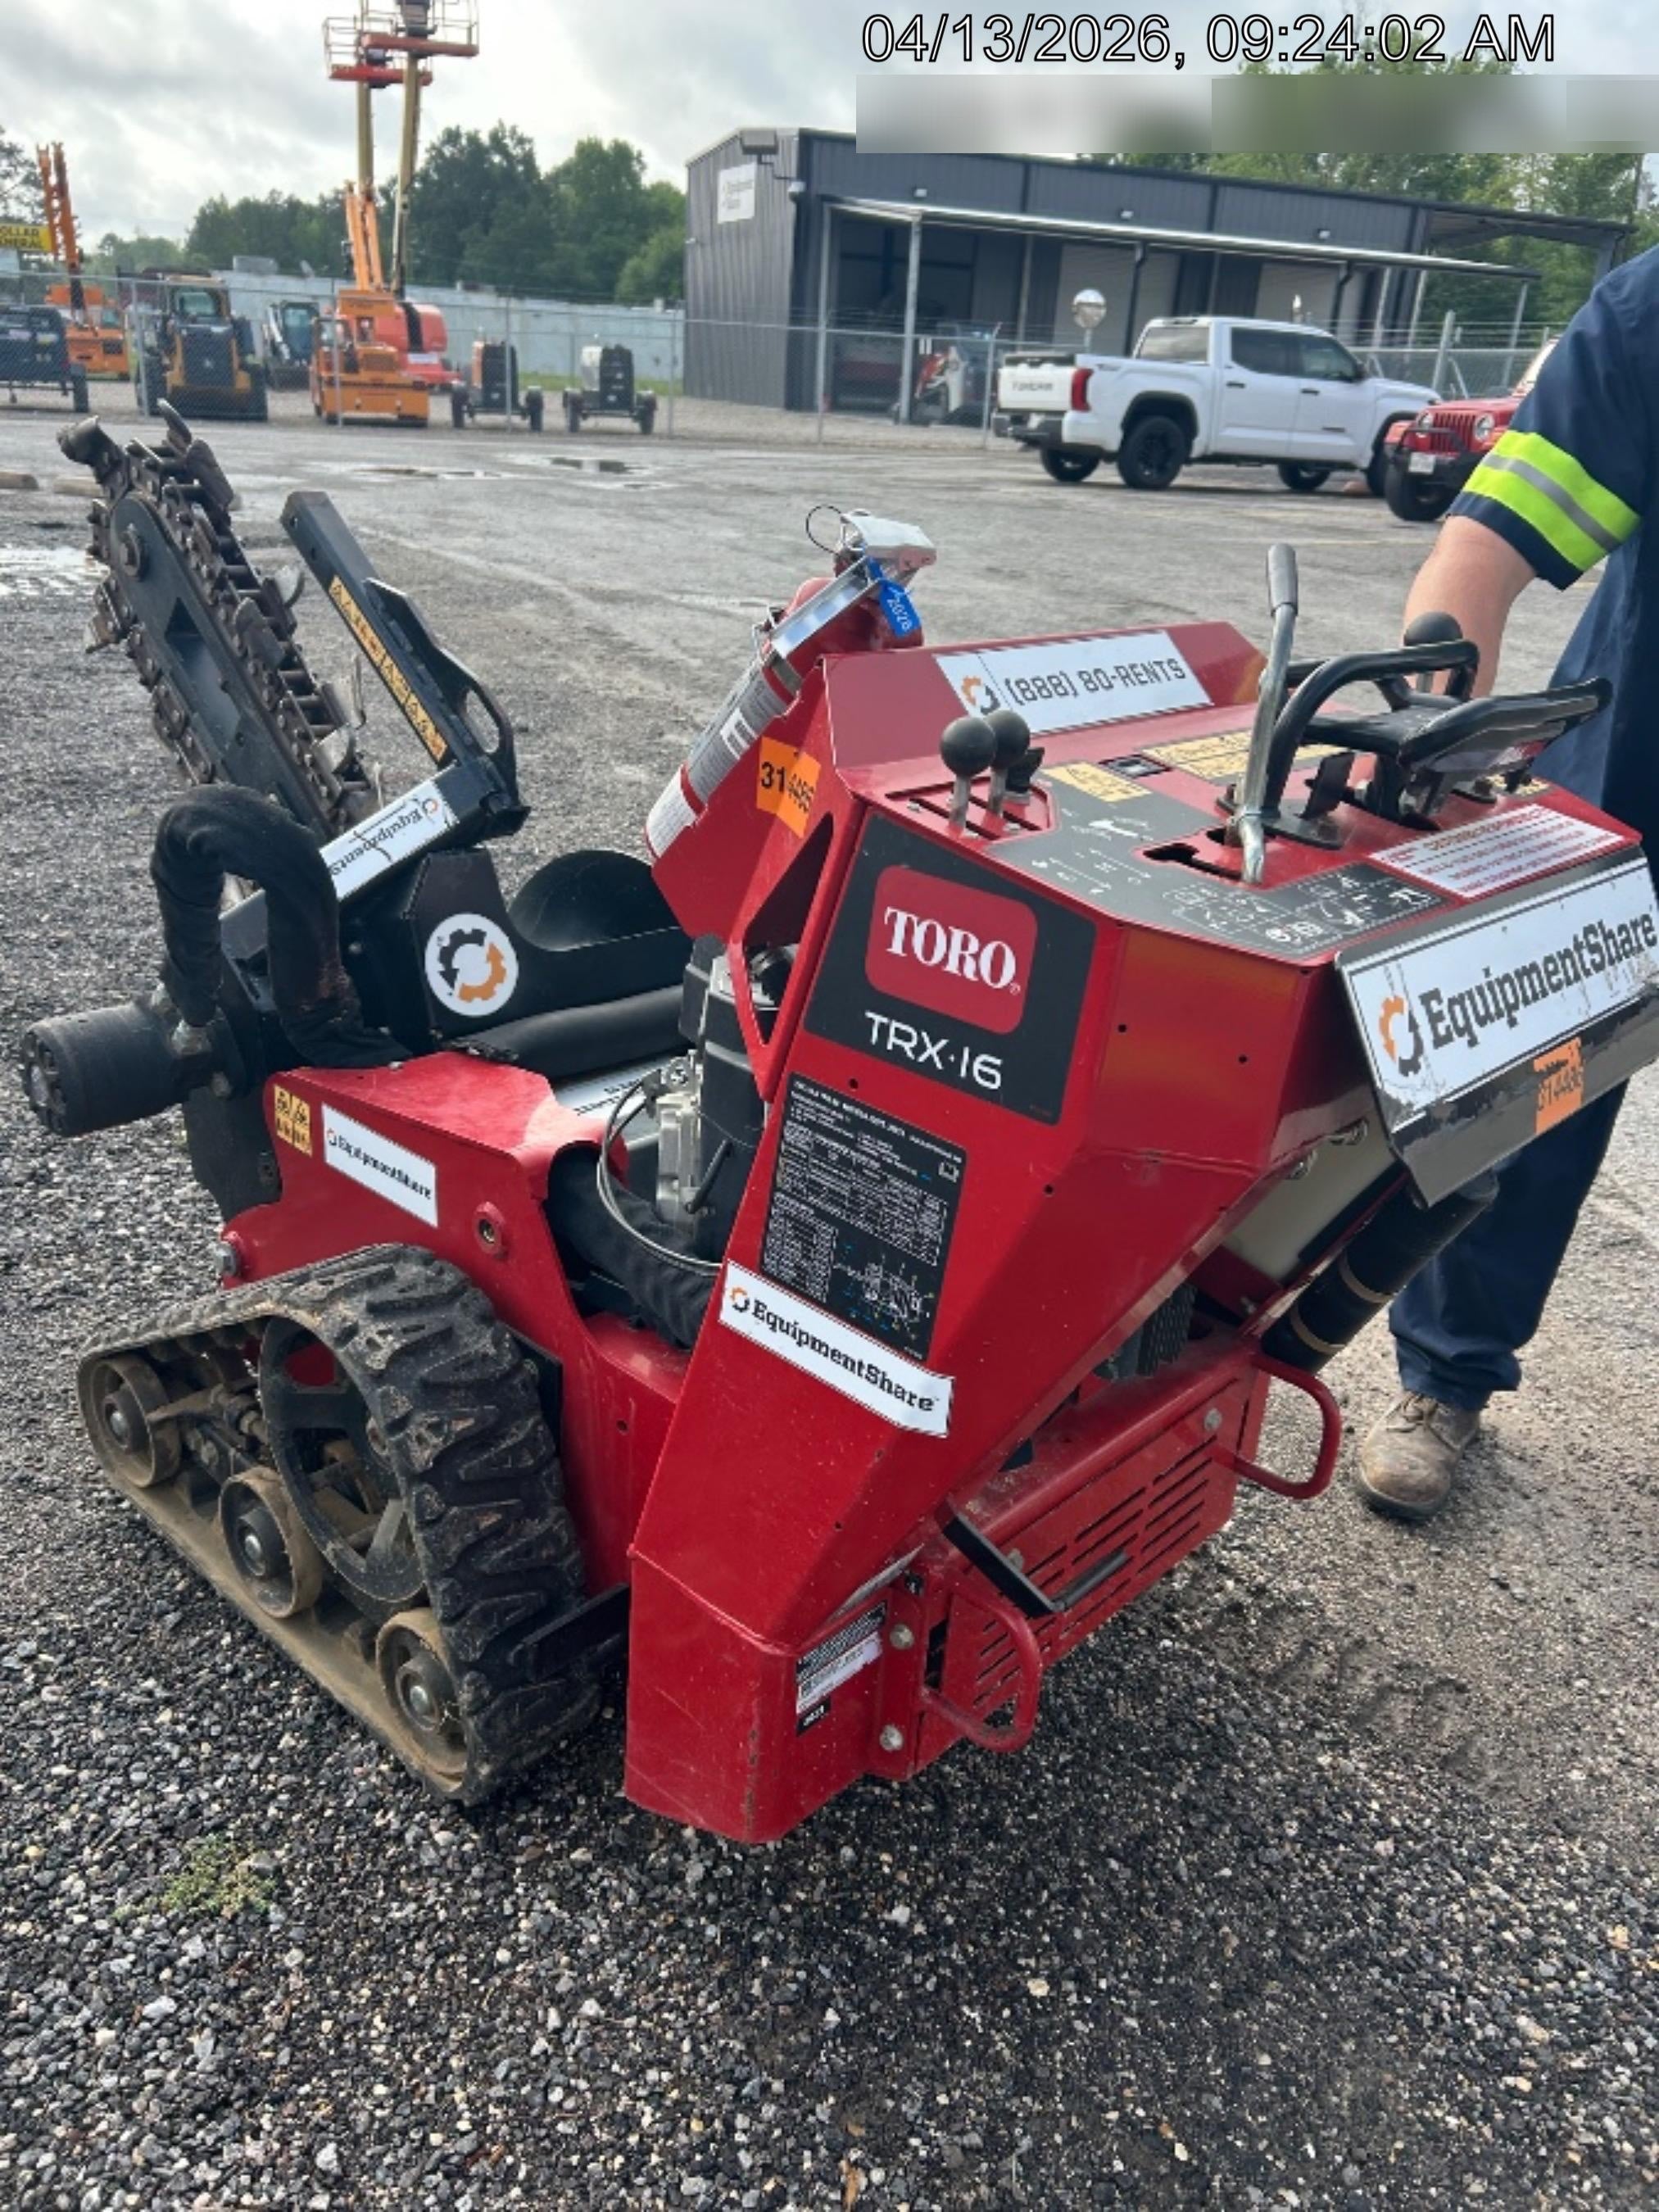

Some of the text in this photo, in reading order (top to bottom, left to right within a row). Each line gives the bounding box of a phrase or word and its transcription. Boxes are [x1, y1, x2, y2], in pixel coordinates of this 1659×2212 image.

[1004, 658, 1186, 706] (888) 80-RENTS
[884, 906, 1017, 990] TORO
[1418, 913, 1658, 1049] EquipmentShare
[752, 1297, 935, 1412] EquipmentShare
